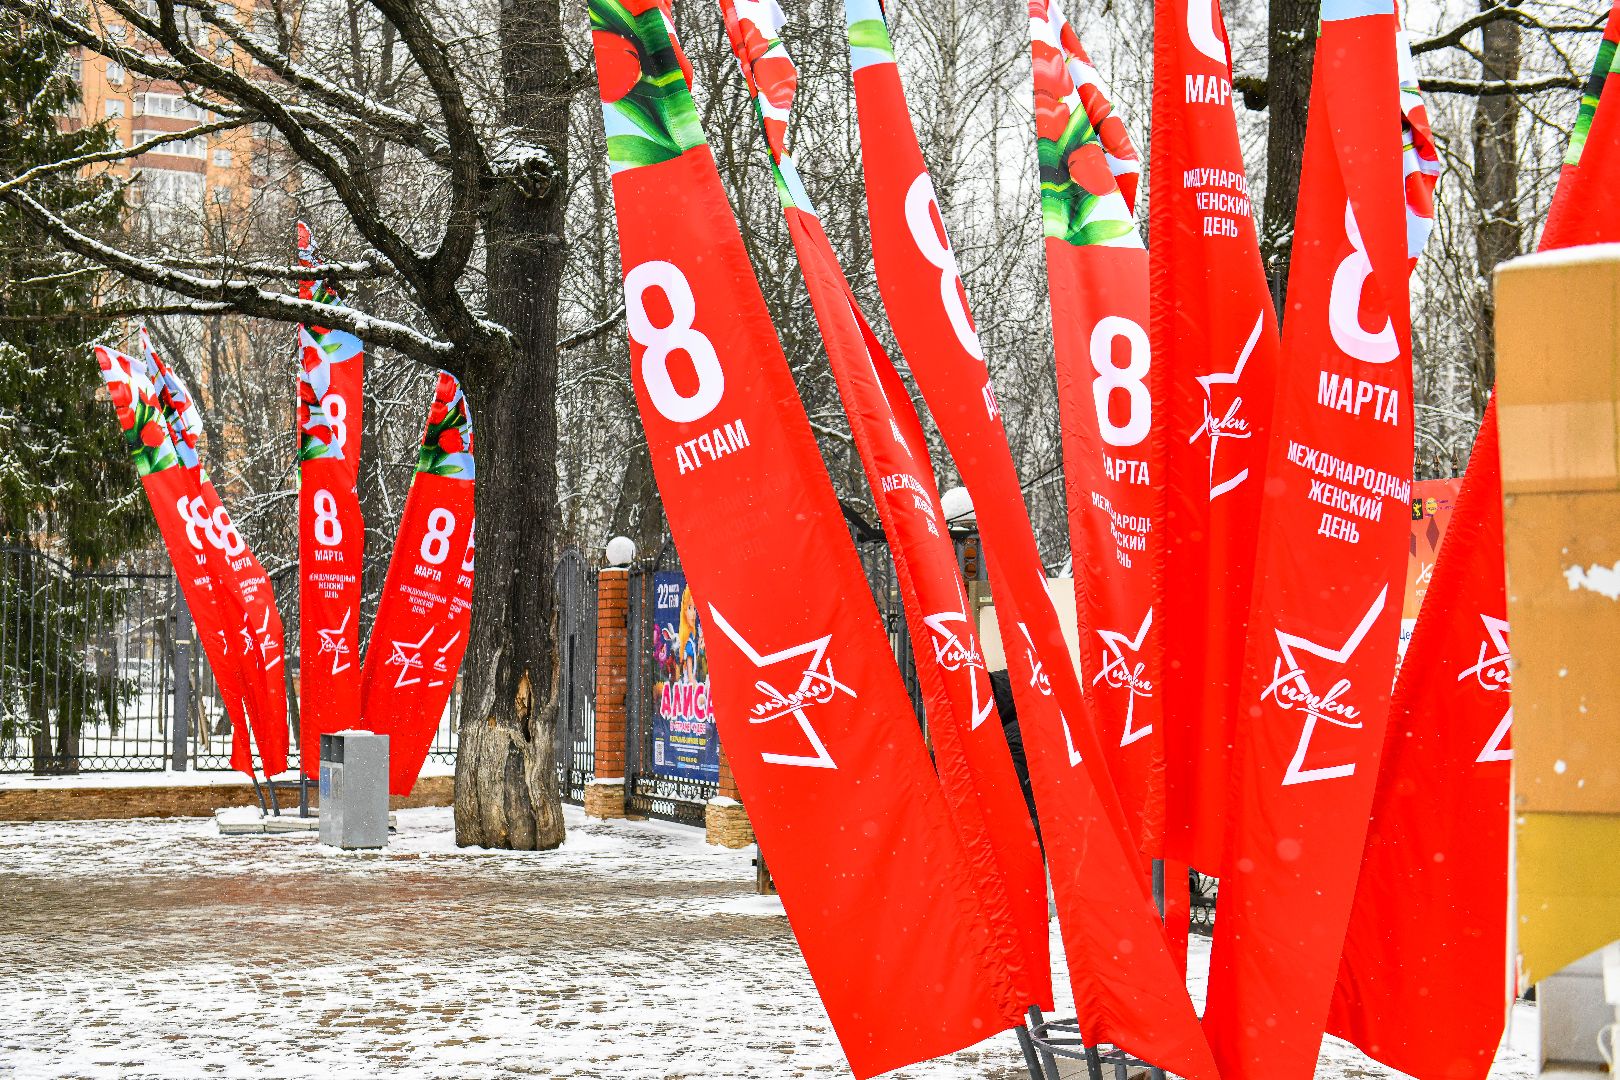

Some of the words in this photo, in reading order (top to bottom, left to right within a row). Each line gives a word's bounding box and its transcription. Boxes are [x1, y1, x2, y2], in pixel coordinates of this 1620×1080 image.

[1185, 74, 1232, 106] МАР
[1203, 216, 1239, 238] ДЕНЬ
[1089, 315, 1152, 447] 8
[1317, 370, 1399, 427] МАРТА
[1102, 451, 1150, 486] АРТА
[1287, 439, 1411, 506] МЕЖДУНАРОДНЫЙ
[313, 488, 343, 547] 8
[1307, 478, 1384, 523] ЖЕНСКИЙ
[212, 505, 246, 557] 8
[420, 507, 457, 565] 8
[1317, 512, 1361, 544] ДЕНЬ
[314, 549, 344, 562] МАРТА
[413, 564, 442, 582] МАРТА
[657, 583, 669, 609] 22
[660, 681, 716, 724] АЛИСА
